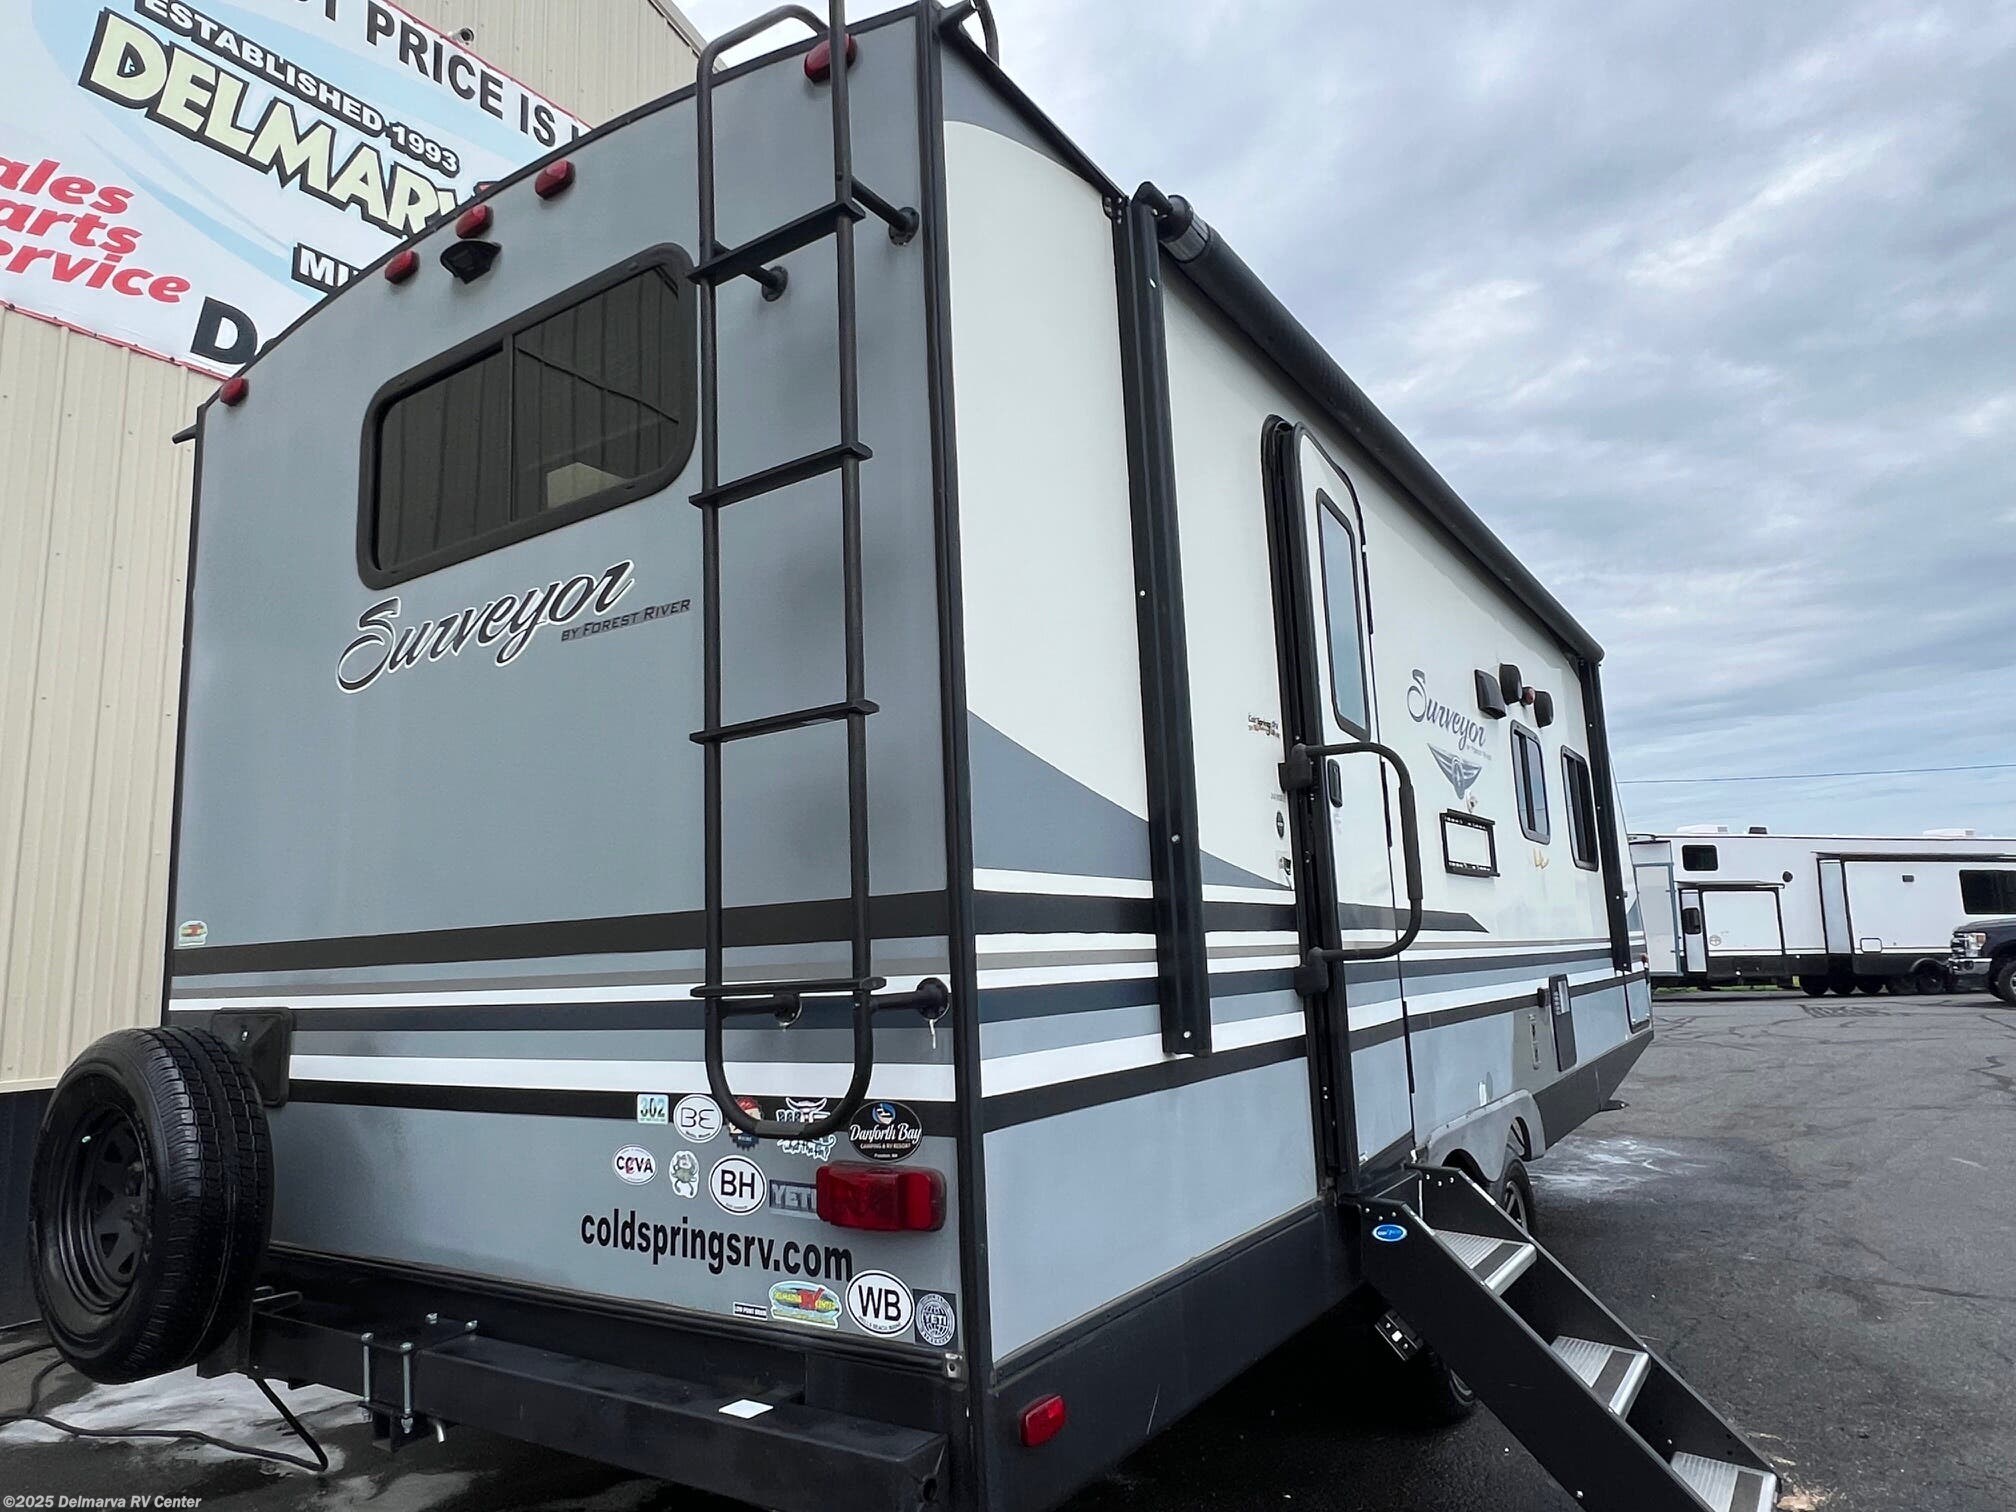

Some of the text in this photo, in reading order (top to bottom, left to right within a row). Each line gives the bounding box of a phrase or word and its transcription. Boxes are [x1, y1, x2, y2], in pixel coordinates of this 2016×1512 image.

[143, 0, 460, 174] ESTABLISHED 1993
[366, 2, 556, 148] PRICE IS
[299, 246, 359, 287] MI
[336, 560, 633, 692] Surveyor
[561, 599, 691, 641] BY FOREST RIVER
[1407, 669, 1485, 750] Surveyor
[849, 1123, 921, 1144] Danforth Bay
[721, 1169, 755, 1199] BH
[771, 1184, 817, 1209] YETI
[581, 1208, 852, 1282] coldspringsrv.com
[858, 1285, 902, 1321] WB
[924, 1313, 947, 1326] YETI
